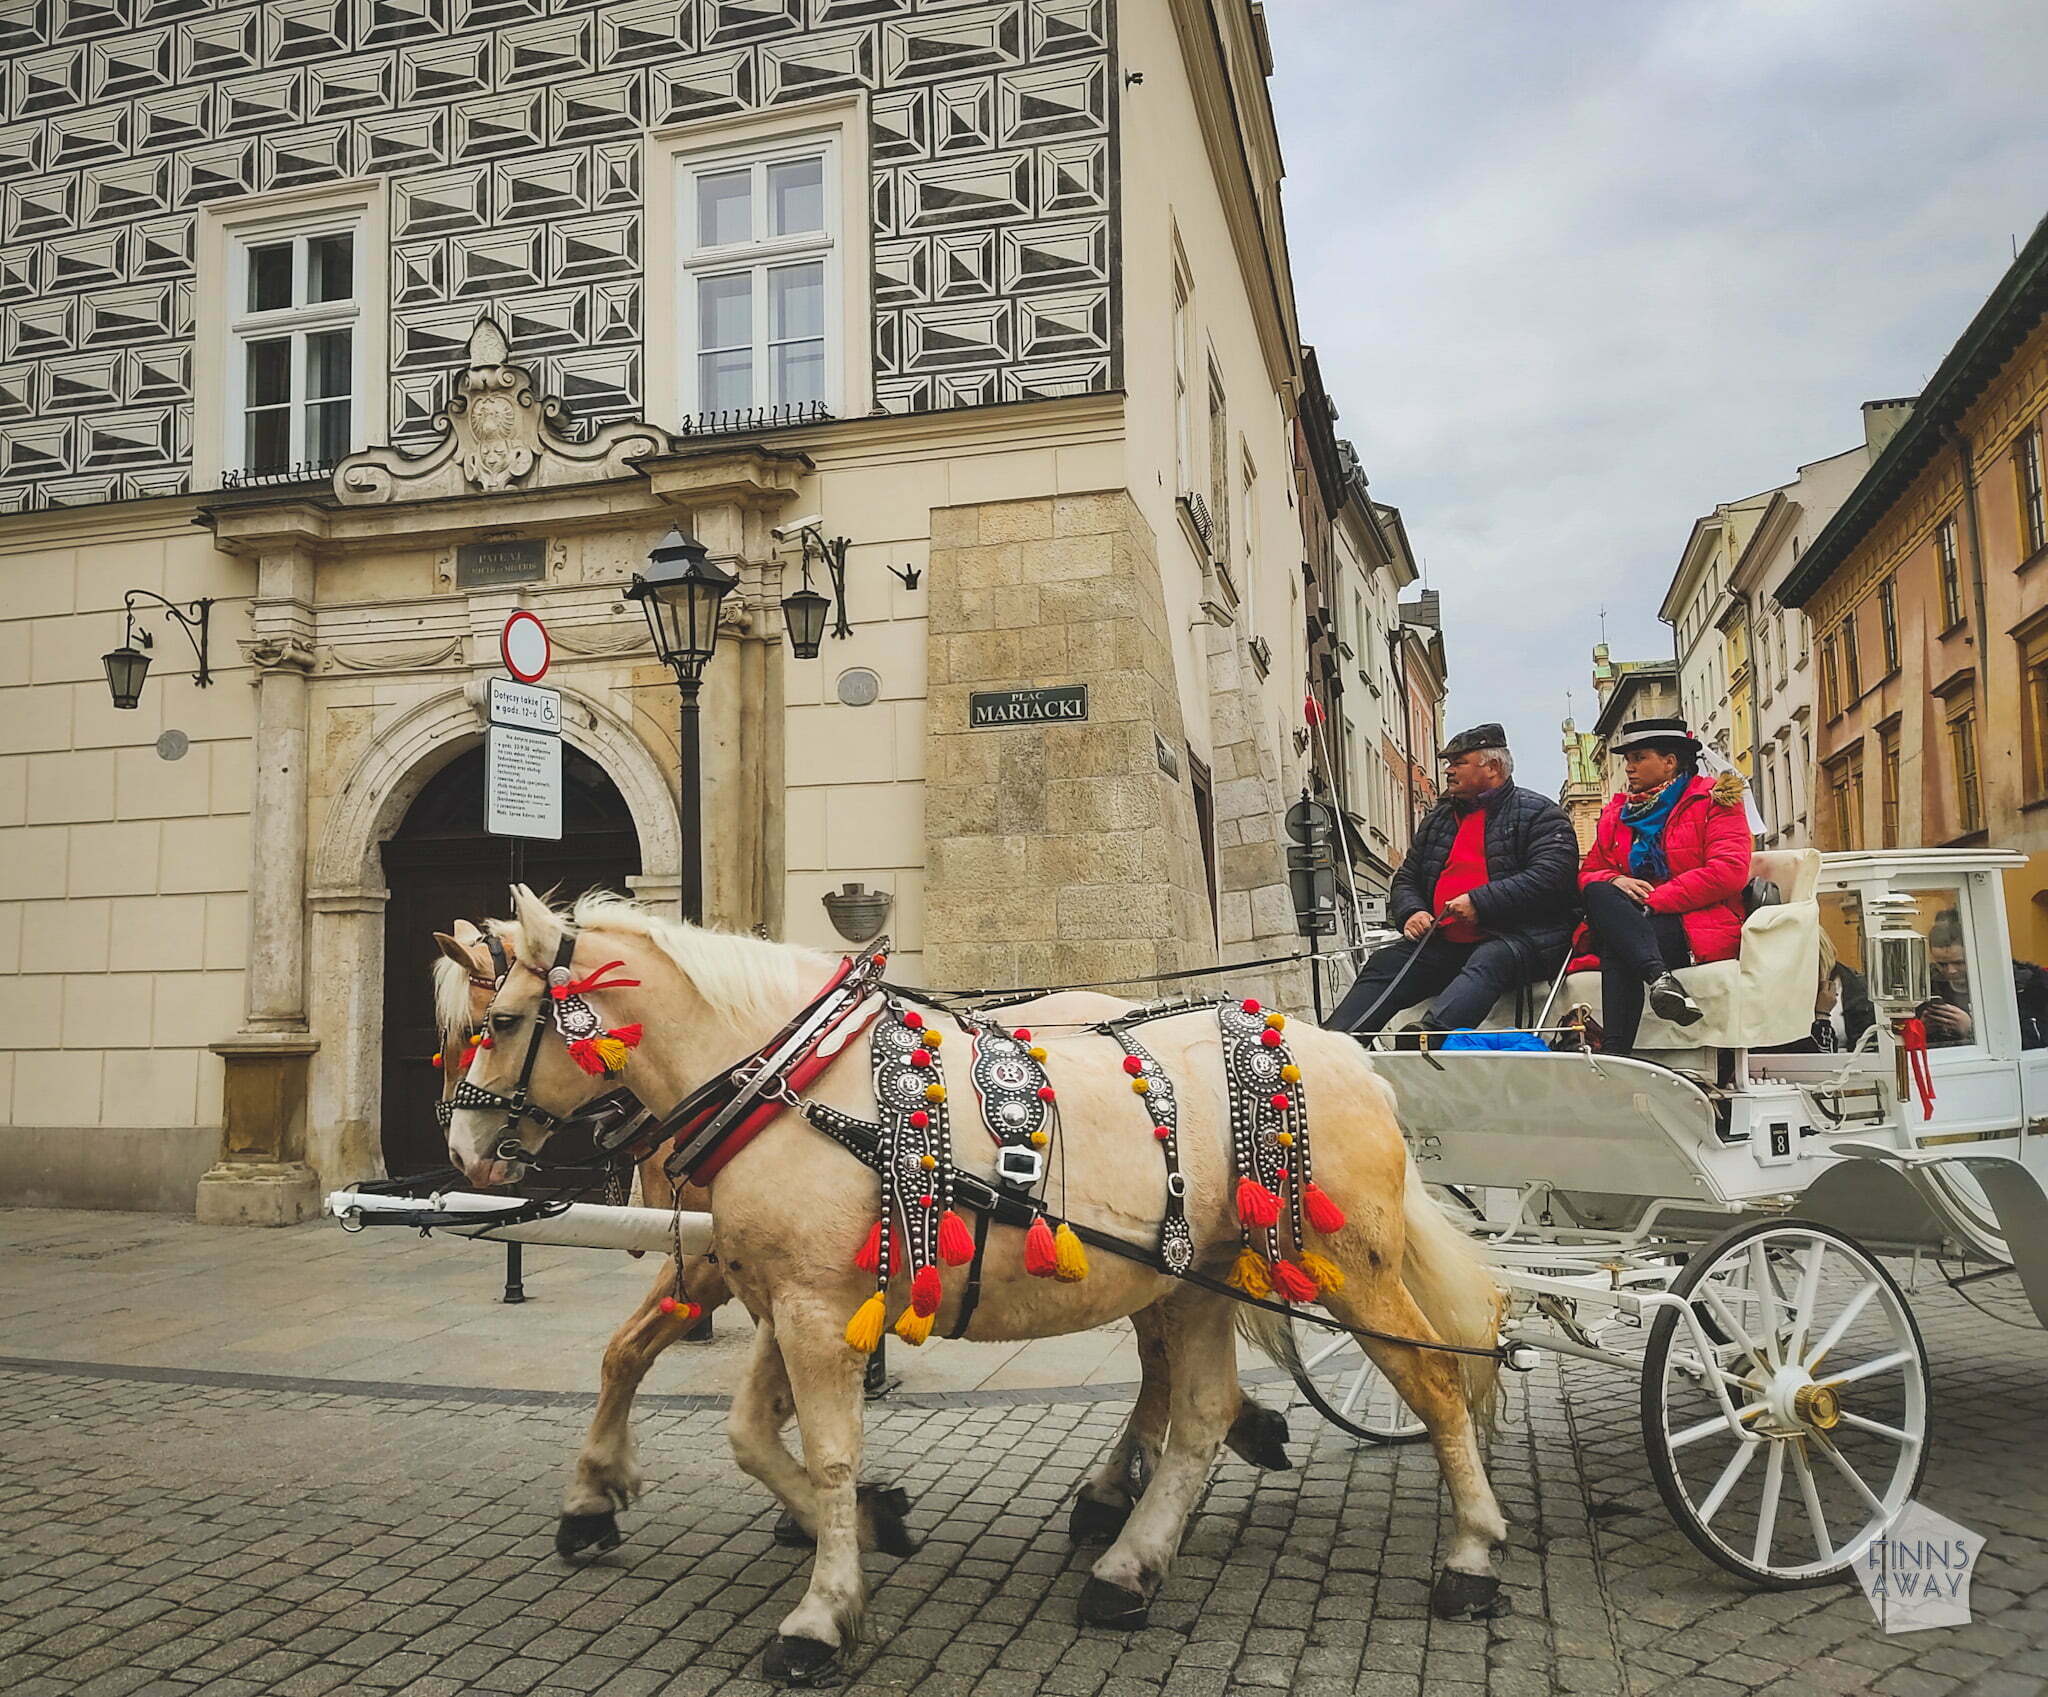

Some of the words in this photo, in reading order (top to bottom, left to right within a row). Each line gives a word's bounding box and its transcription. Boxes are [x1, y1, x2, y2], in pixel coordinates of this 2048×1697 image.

[494, 689, 519, 704] Dotyczy
[1011, 692, 1045, 702] PLAC
[976, 700, 1083, 723] MARIACKI
[1777, 1135, 1785, 1153] 8
